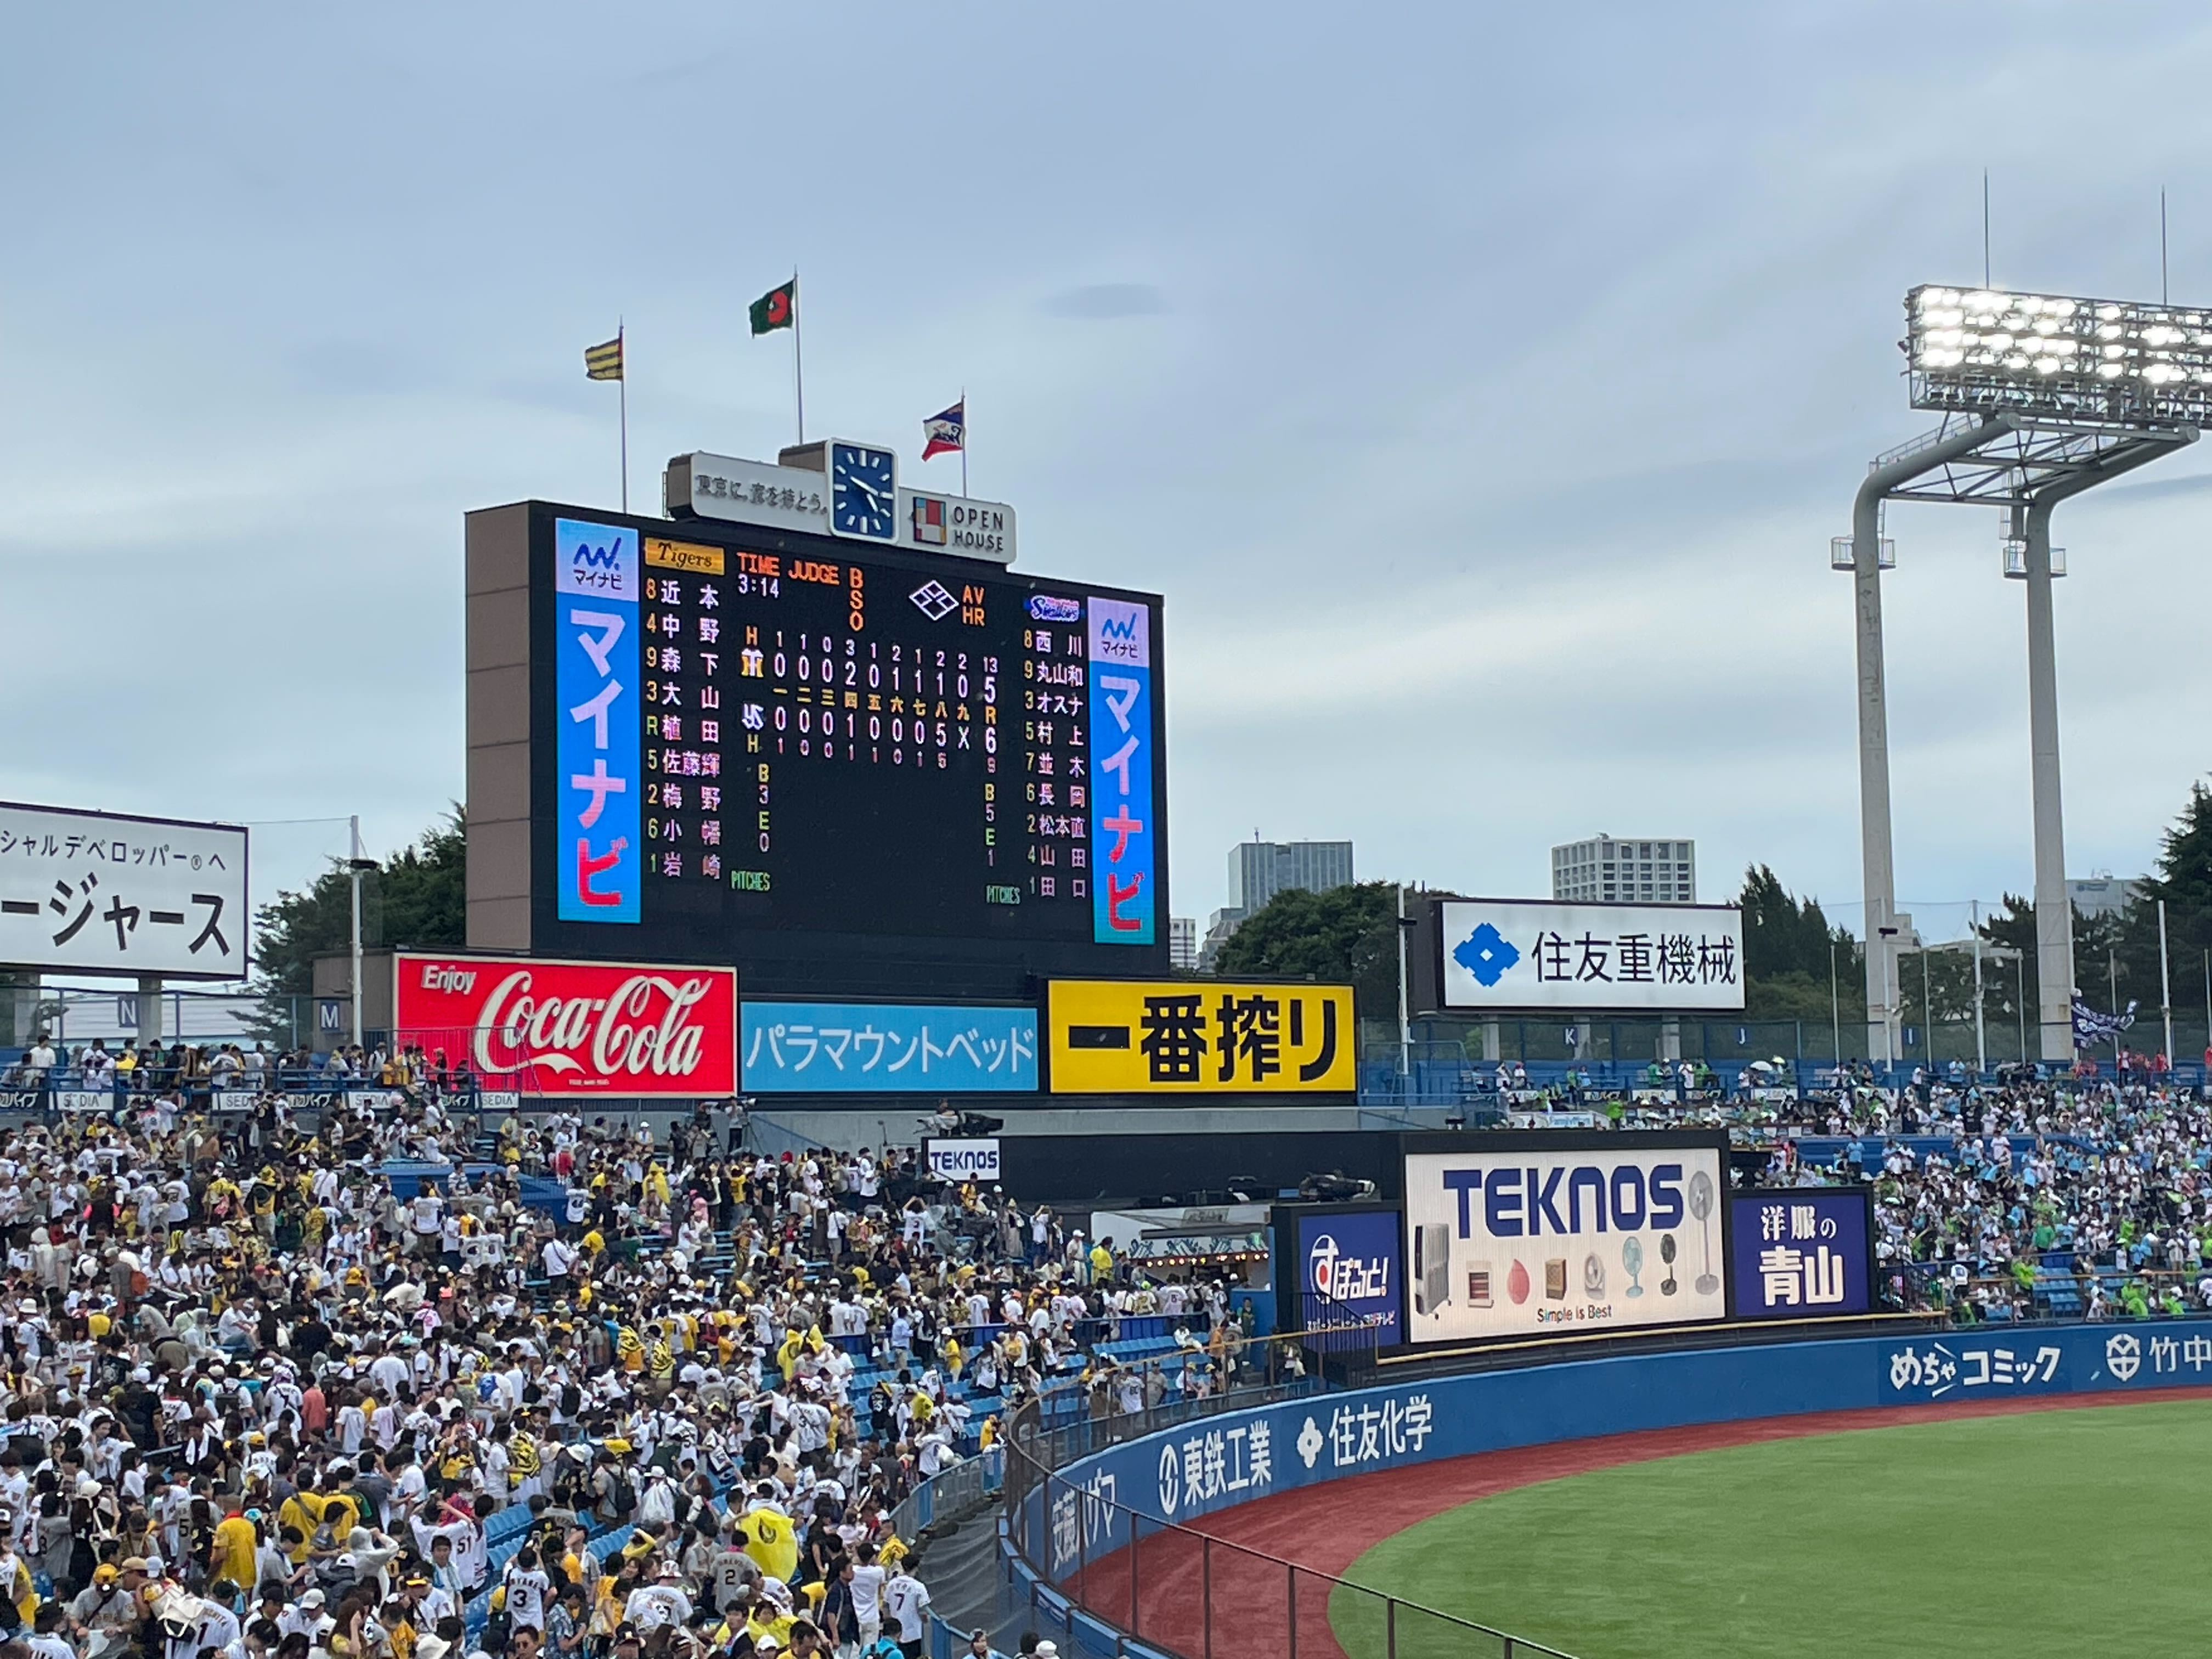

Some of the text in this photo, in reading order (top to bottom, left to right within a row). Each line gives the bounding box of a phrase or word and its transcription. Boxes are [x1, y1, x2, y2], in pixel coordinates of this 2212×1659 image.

[954, 506, 1003, 531] OPEN
[953, 529, 1003, 551] HOUSE
[658, 542, 712, 568] Tigers
[573, 569, 622, 590] マイナビ
[737, 552, 839, 584] TIME JUDGE
[850, 568, 863, 588] B
[646, 578, 718, 609] 8 近本
[739, 572, 780, 597] 3:14
[963, 585, 984, 604] AV
[850, 590, 863, 609] S
[963, 606, 984, 625] HR
[647, 613, 719, 643] 4 中野
[747, 627, 997, 673] H 1 1 0 3 1 2 1 2 2 13
[1025, 630, 1081, 657] 8 西川
[1102, 641, 1138, 658] マイナビ
[647, 647, 718, 675] 9 森下
[775, 653, 995, 703] 0 0 0 2 0 1 1 1 0 5
[1025, 661, 1083, 686] 9 丸山和
[647, 681, 718, 708] 3 大山
[798, 688, 811, 702] 二
[821, 690, 835, 706] 三
[845, 692, 857, 709] 四
[868, 695, 881, 710] 五
[890, 696, 903, 713] 六
[913, 699, 926, 715] 七
[936, 702, 947, 718] 八
[957, 703, 969, 720] 九
[986, 706, 996, 724] R
[1025, 691, 1083, 716] 3 オスナ
[647, 716, 657, 735] R
[776, 707, 996, 753] 0 0 0 1 0 0 0 5 X 6
[1026, 721, 1084, 745] 5 村上
[570, 609, 629, 906] マイナビ
[648, 749, 657, 769] 5
[748, 734, 758, 753] H
[778, 738, 782, 753] 1
[801, 740, 809, 755] 0
[825, 742, 832, 758] 0
[849, 744, 853, 760] 1
[873, 747, 877, 762] 1
[894, 749, 902, 764] 0
[917, 751, 922, 766] 1
[1026, 753, 1034, 770] 7
[759, 764, 769, 782] B
[648, 783, 720, 811] 2 梅野
[759, 785, 768, 803] 3
[985, 784, 994, 800] B
[1027, 783, 1034, 801] 6
[1101, 675, 1145, 932] マイナビ
[759, 811, 769, 830] E
[986, 804, 994, 821] 5
[1027, 815, 1035, 832] 2
[648, 818, 658, 838] 6
[986, 828, 995, 845] E
[651, 854, 656, 872] 1
[989, 849, 992, 866] 1
[1028, 845, 1085, 867] 4 山田
[732, 871, 770, 890] PITCHES
[1030, 877, 1085, 898] 1 田口
[987, 885, 1020, 904] PITCHES
[1, 872, 230, 956] ージャース
[1532, 931, 1736, 985] 住友重機械
[422, 965, 477, 995] Enjoy
[121, 998, 136, 1025] N
[321, 1005, 338, 1029] M
[474, 970, 712, 1075] Coca-Cola
[746, 1022, 1034, 1075] パラマウントベッド
[1069, 994, 1336, 1083] 一番搾り
[1565, 1029, 1576, 1044] K
[1739, 1029, 1746, 1045] J
[930, 1150, 997, 1170] TEKNOS
[1443, 1165, 1683, 1239] TEKNOS
[1760, 1205, 1837, 1241] 洋服の
[1758, 1245, 1845, 1307] 青山
[1537, 1304, 1612, 1324] Simple Best
[2149, 1334, 2211, 1373] 竹中
[1890, 1346, 2061, 1391] めちゃコミック
[1330, 1394, 1432, 1468] 住友化学
[1184, 1420, 1272, 1506] 東鉄工業
[179, 1519, 189, 1537] 5
[458, 1535, 471, 1554] 51
[725, 1569, 736, 1585] 2
[512, 1589, 527, 1607] 3
[894, 1593, 905, 1611] 7
[197, 1622, 208, 1646] 1
